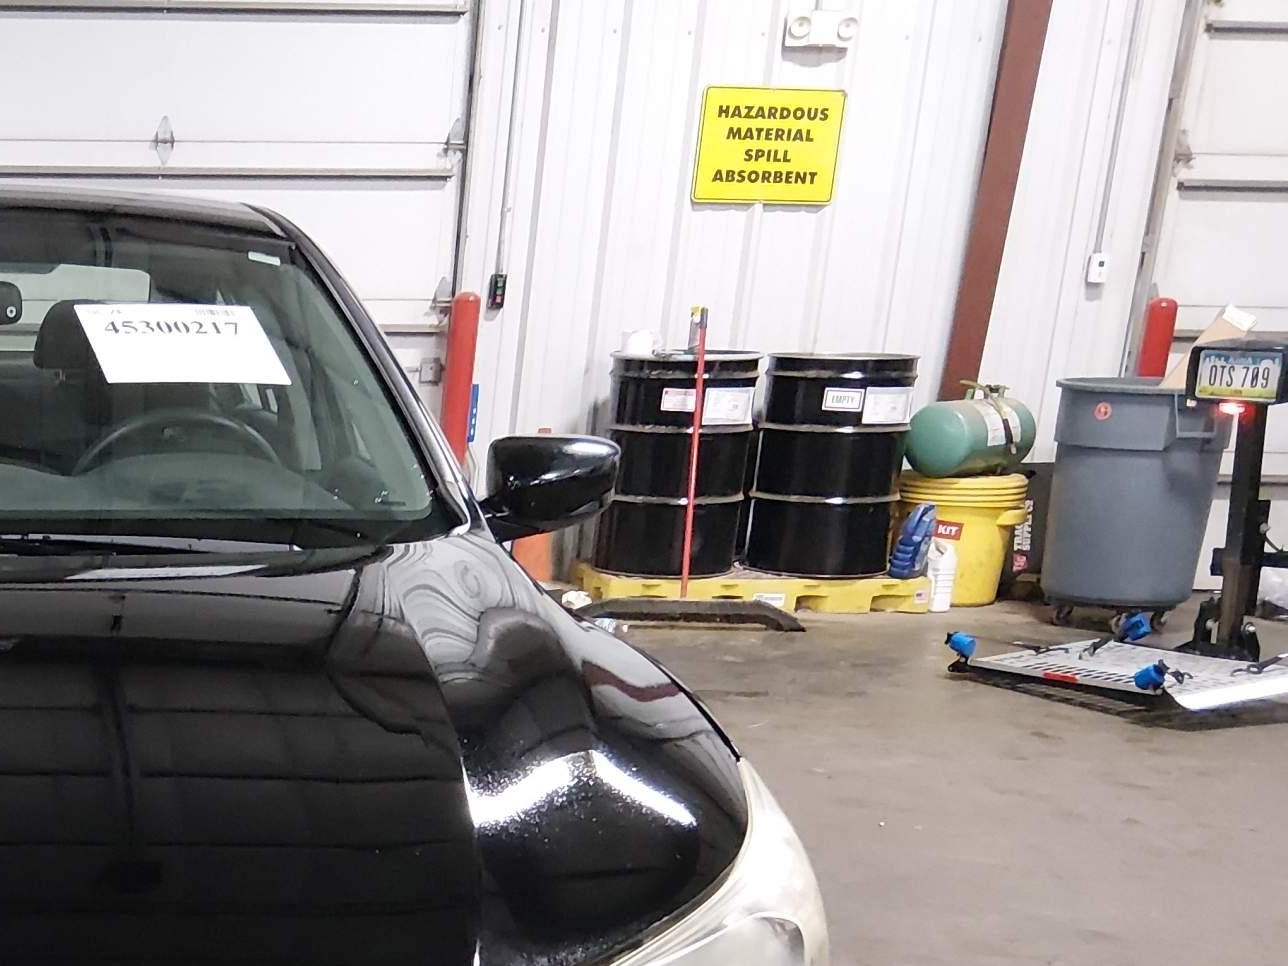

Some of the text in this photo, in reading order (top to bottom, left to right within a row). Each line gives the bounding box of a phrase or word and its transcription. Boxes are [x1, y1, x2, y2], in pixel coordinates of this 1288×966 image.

[717, 105, 829, 121] HAZARDOUS
[726, 126, 814, 142] MATERIAL
[743, 148, 792, 163] SPILL
[711, 169, 818, 185] ABSORBENT
[105, 321, 238, 335] 45300217
[1209, 365, 1270, 389] OTS 709
[831, 394, 855, 405] EMPTY
[937, 524, 959, 535] KIT
[1014, 525, 1022, 551] TRAC
